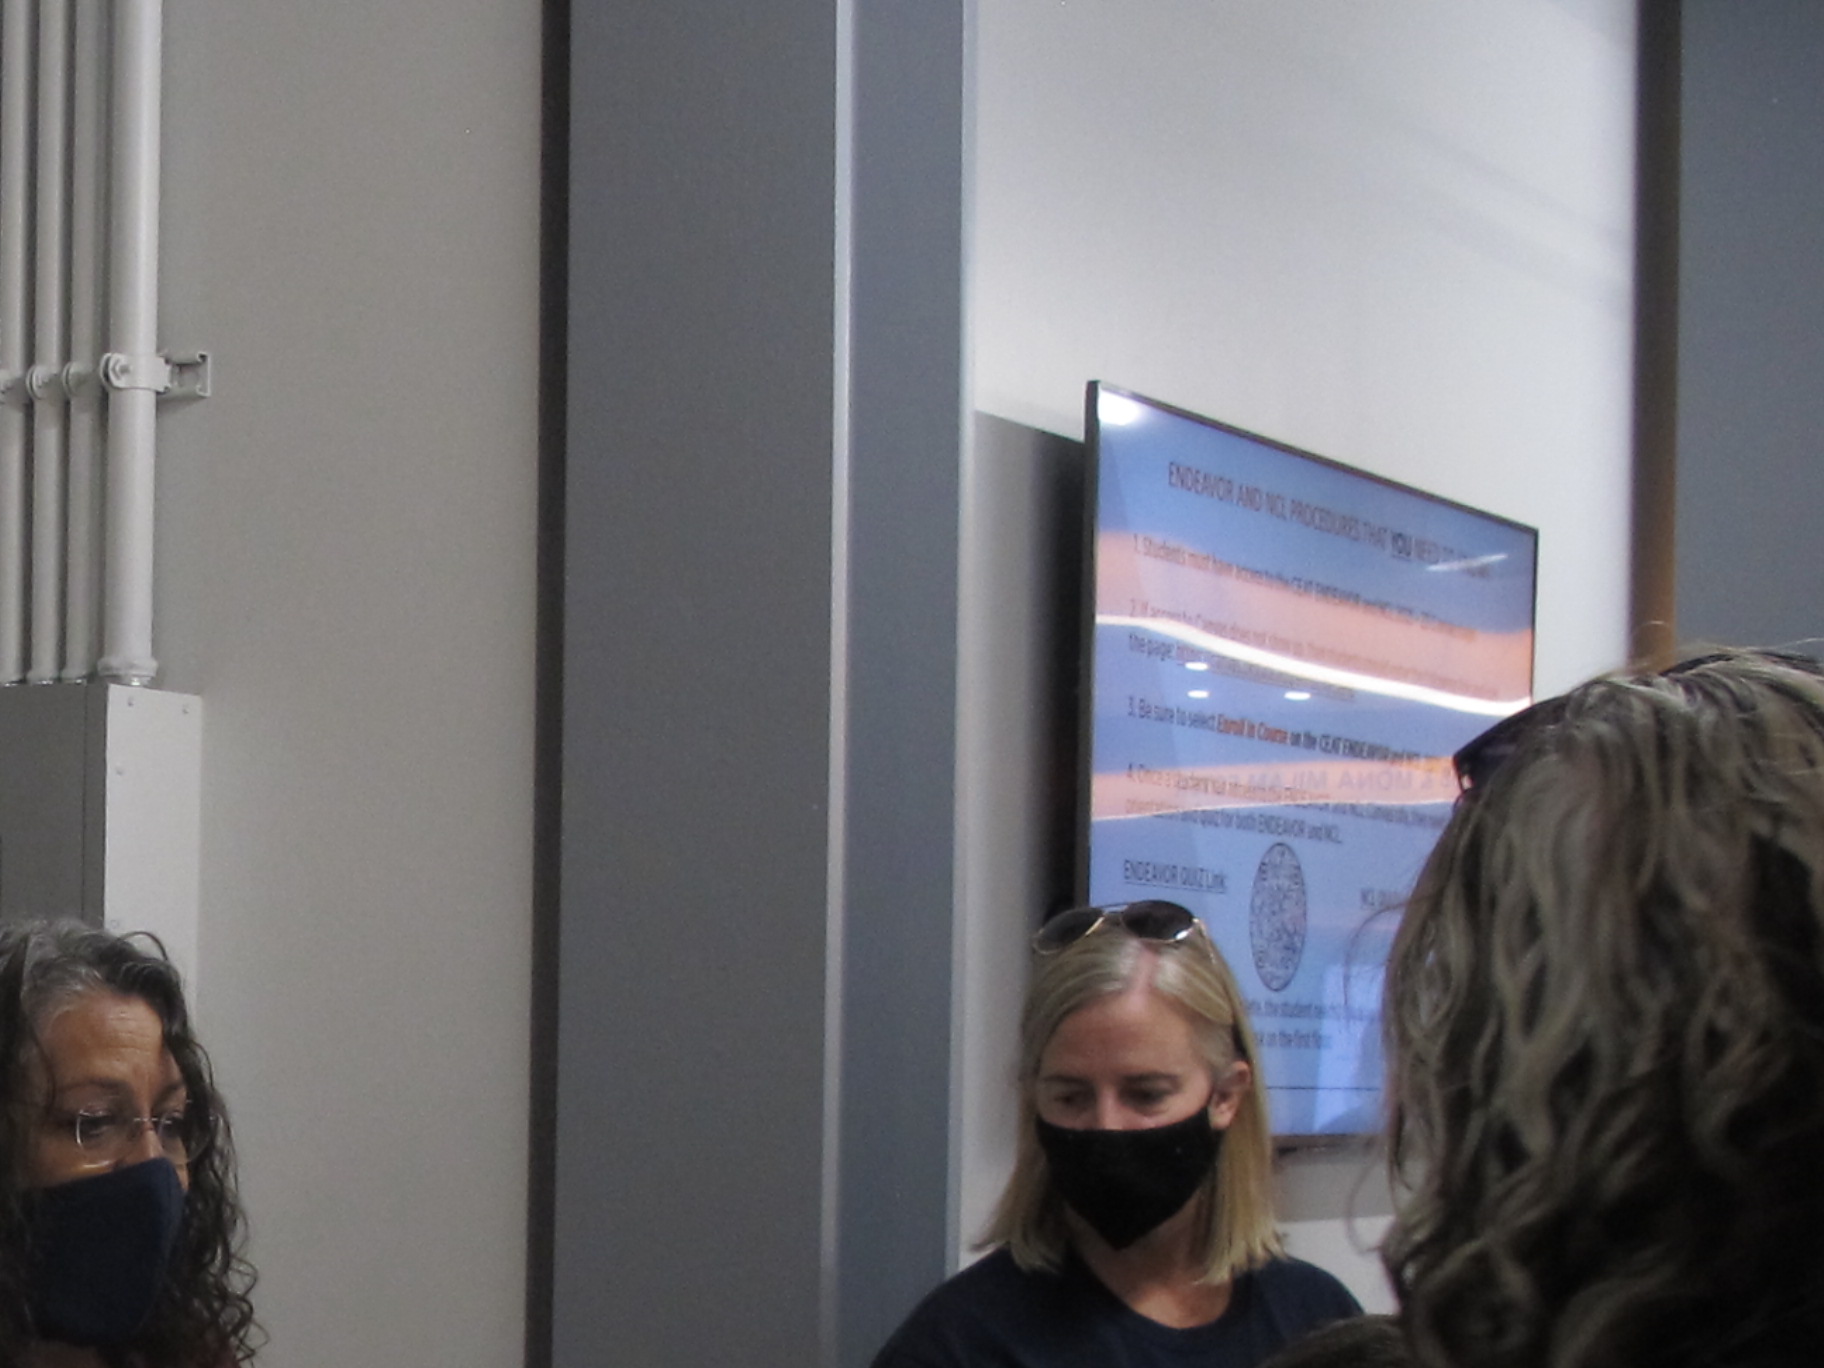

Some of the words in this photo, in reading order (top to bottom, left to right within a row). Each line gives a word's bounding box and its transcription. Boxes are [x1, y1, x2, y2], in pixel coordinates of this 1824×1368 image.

[1168, 461, 1234, 503] ENDEAVOR
[1390, 530, 1411, 560] YOU
[1143, 536, 1186, 566] Students
[1139, 700, 1152, 719] Be
[1154, 706, 1174, 724] sure
[1176, 708, 1186, 725] to
[1188, 710, 1215, 731] select
[1319, 733, 1340, 754] CEAT
[1257, 814, 1305, 838] ENDEAVOR
[1123, 859, 1177, 884] ENDEAVOR
[1180, 864, 1204, 888] QUIZ
